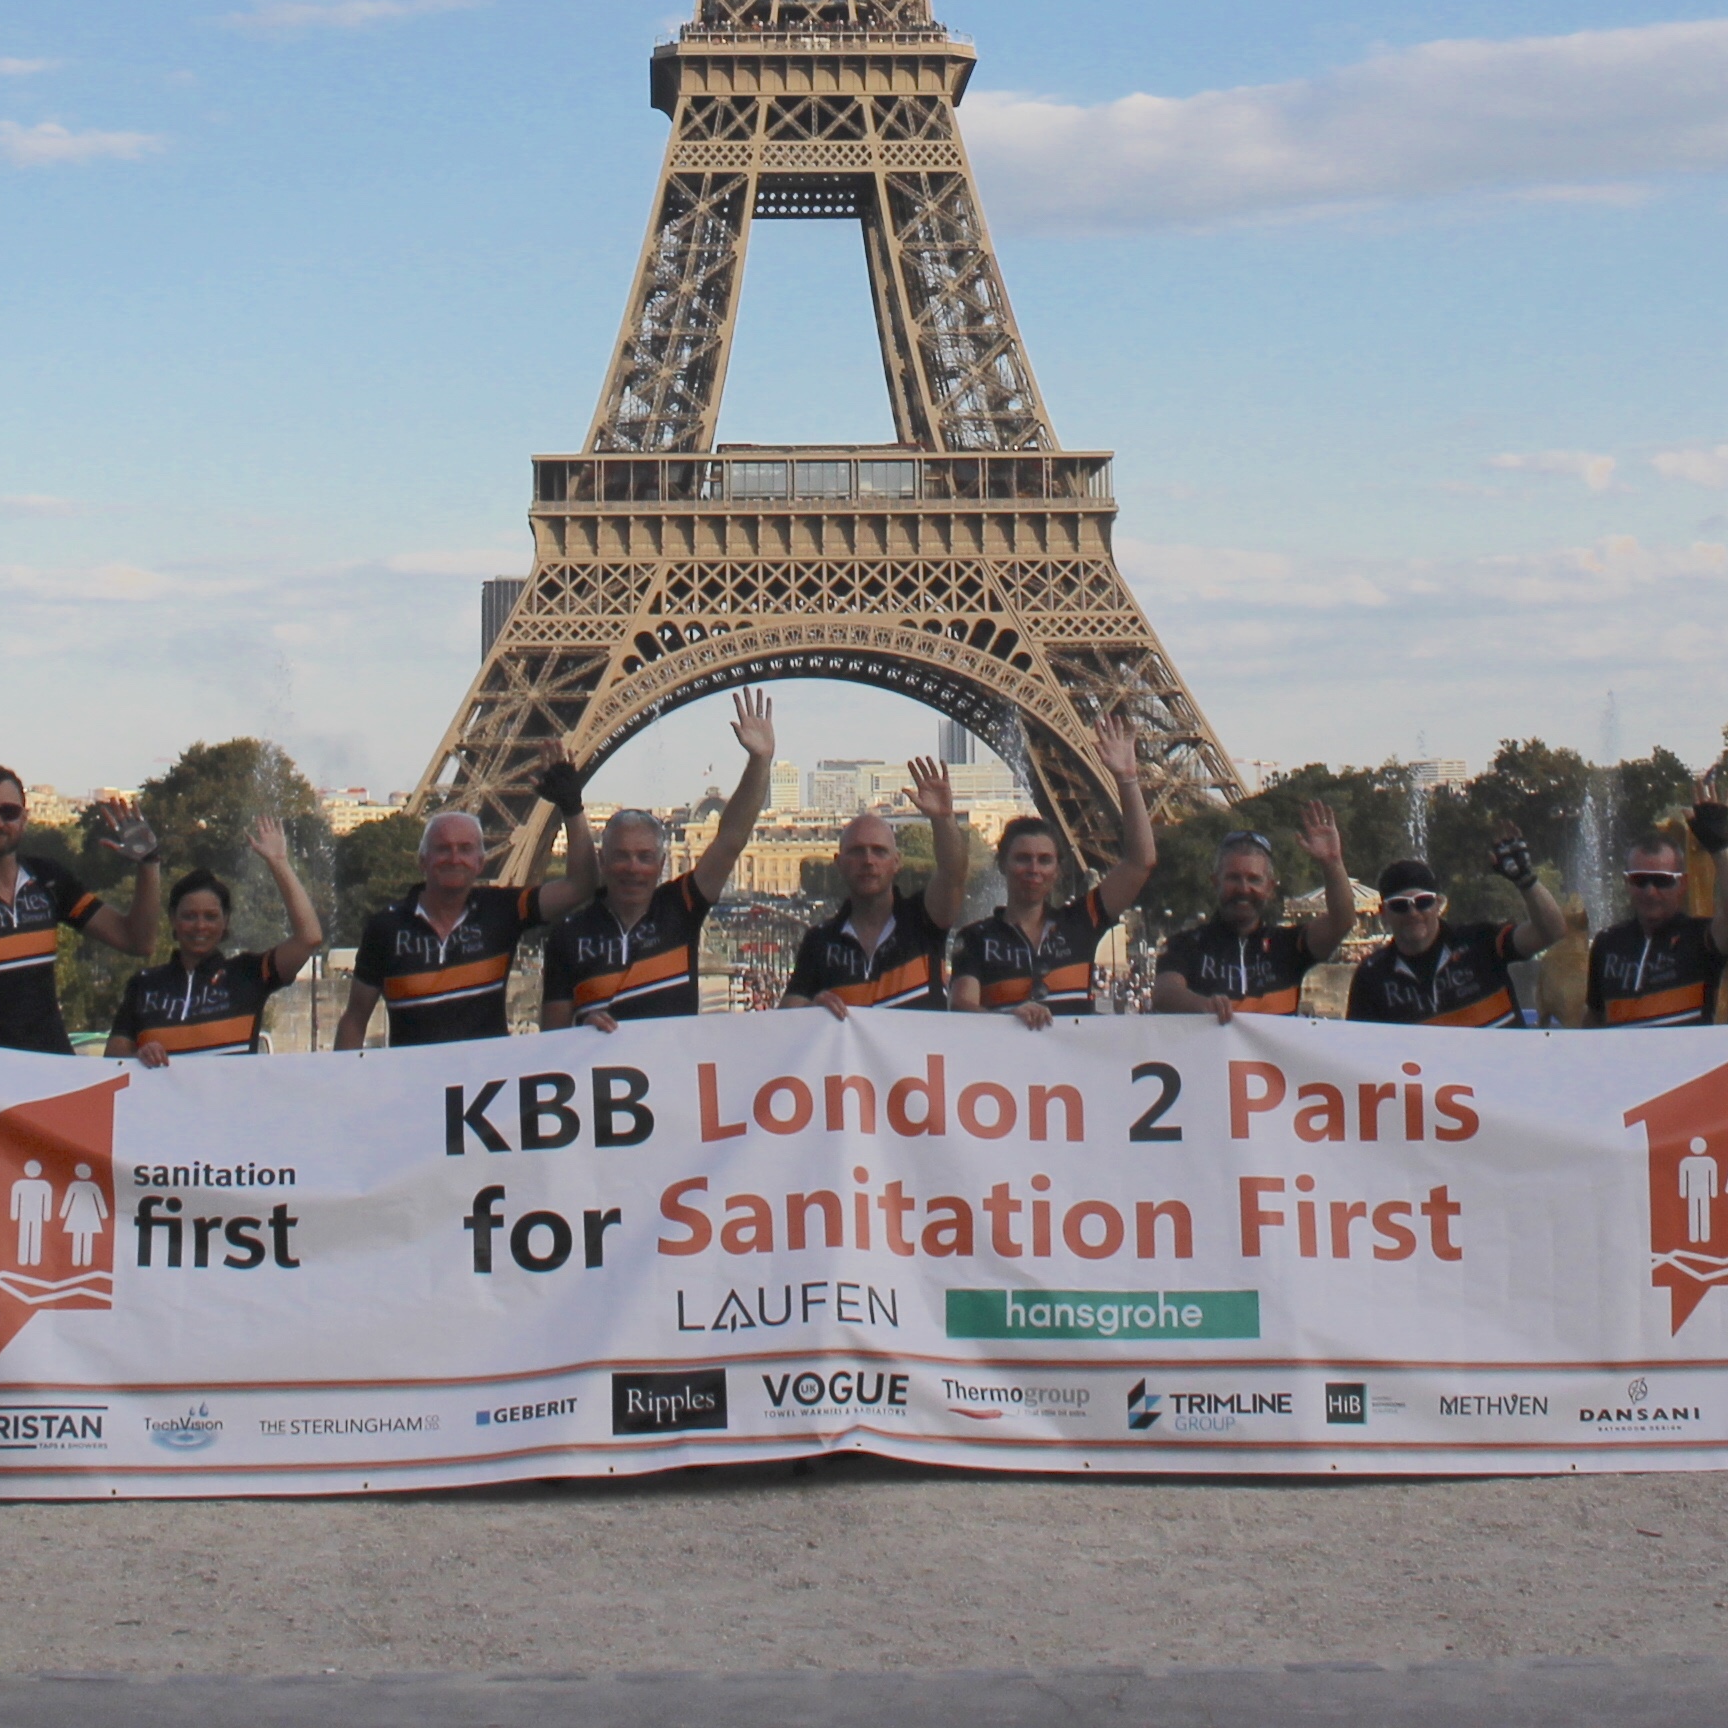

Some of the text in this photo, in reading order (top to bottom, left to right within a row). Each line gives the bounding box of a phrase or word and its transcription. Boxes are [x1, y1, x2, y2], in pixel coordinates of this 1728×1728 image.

[395, 924, 483, 964] Ripes
[577, 923, 658, 964] Ripes
[445, 1054, 1480, 1156] KBB London 2 Paris
[134, 1161, 296, 1187] sanitation
[134, 1196, 301, 1270] first
[463, 1165, 1463, 1273] for Sanitation First
[677, 1281, 899, 1333] LAUFEN
[1006, 1289, 1203, 1336] hansgrohe
[761, 1371, 910, 1407] VOGUE
[941, 1378, 1090, 1408] Thermogroup
[493, 1398, 578, 1423] GEBERIT
[626, 1386, 716, 1425] Ripples
[763, 1409, 796, 1419] TOWEL
[1169, 1393, 1292, 1414] TRIMLINE
[1328, 1394, 1361, 1414] HiB
[1439, 1394, 1548, 1416] METHVEN
[1579, 1406, 1700, 1422] DANSANI
[145, 1416, 224, 1433] TechVision
[259, 1416, 423, 1436] THE STERLINGHAM
[1175, 1415, 1236, 1431] GROUP
